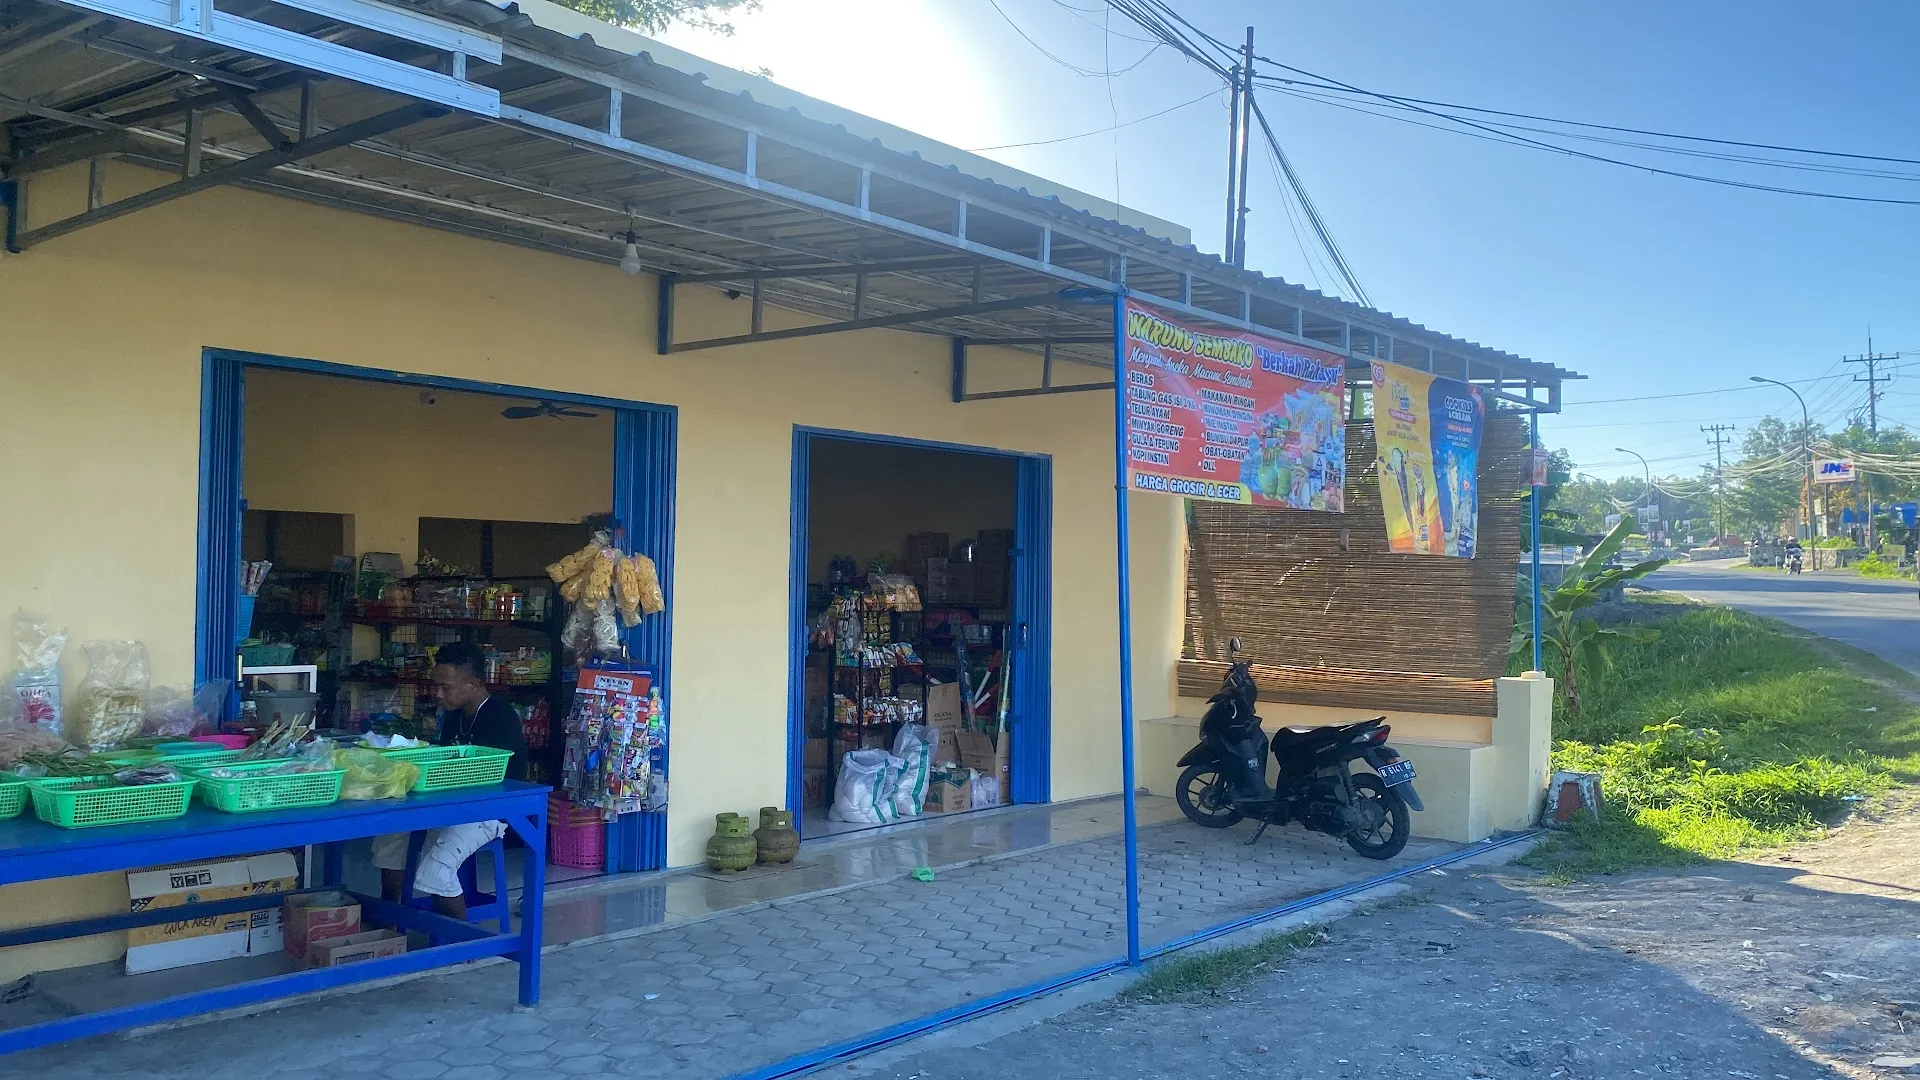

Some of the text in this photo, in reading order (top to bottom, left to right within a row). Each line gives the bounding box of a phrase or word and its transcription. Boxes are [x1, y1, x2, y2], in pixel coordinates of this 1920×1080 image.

[1128, 308, 1254, 369] WARUNG SEMBAKO
[1131, 371, 1154, 387] BERAS
[1163, 357, 1190, 375] Aneka
[1189, 363, 1220, 382] Macam
[1131, 386, 1156, 403] TABUNG
[1157, 392, 1173, 406] GAS
[1201, 388, 1256, 410] MAKANAN RINGAN
[1444, 396, 1474, 413] COOKIES
[1131, 402, 1171, 421] TELUR AYAM
[1202, 401, 1232, 418] MINUMAN
[1131, 416, 1184, 438] MINYAK GORENG
[1204, 416, 1239, 433] MIE INSTAN
[1131, 432, 1148, 447] GULA
[1154, 437, 1179, 452] TEPUNG
[1206, 430, 1249, 449] BUMBU DAPUR
[1132, 447, 1169, 465] KOPI INSTAN
[1204, 446, 1246, 462] OBAT-OBATAN
[1202, 460, 1216, 472] DLL
[1821, 463, 1852, 474] JNE
[1136, 473, 1241, 500] HARGA GROSIR & ECER
[164, 920, 190, 935] GULA
[192, 916, 218, 928] AREN
